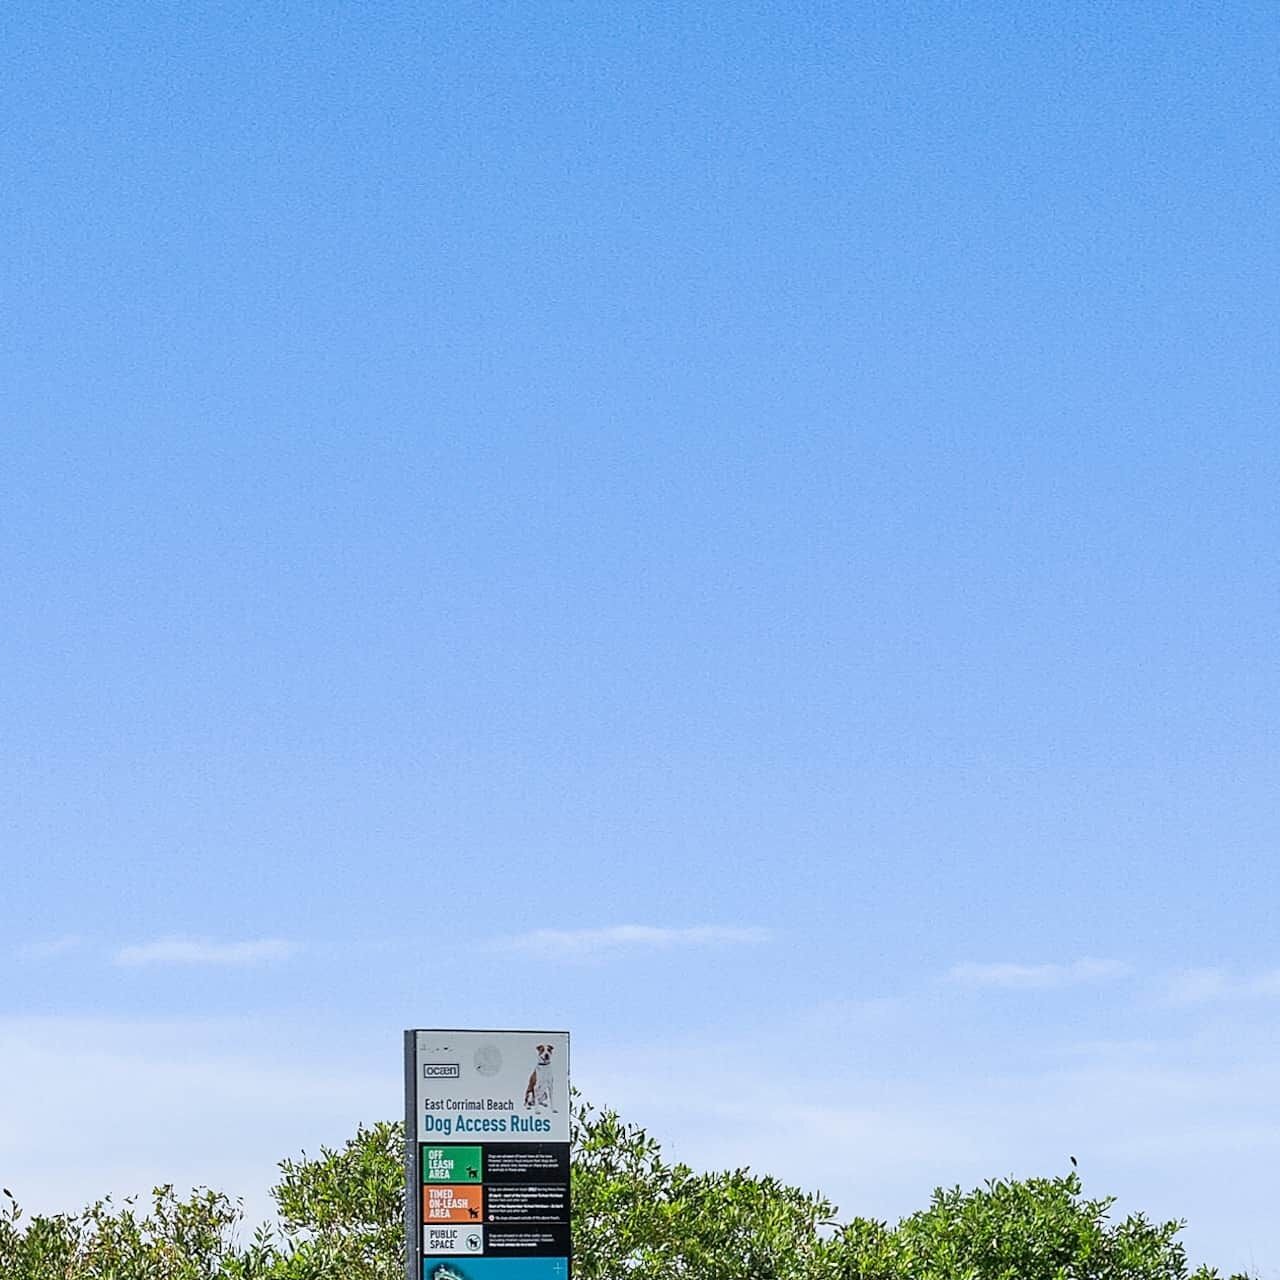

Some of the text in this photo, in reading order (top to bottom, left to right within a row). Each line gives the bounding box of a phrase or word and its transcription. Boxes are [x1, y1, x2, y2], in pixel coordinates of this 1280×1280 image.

[425, 1099, 514, 1110] East Corrimal Beach
[425, 1115, 551, 1135] Dog Access Rules
[428, 1150, 443, 1160] OFF
[428, 1160, 454, 1169] LEASH
[428, 1170, 451, 1179] AREA
[429, 1189, 454, 1198] TIMED
[429, 1199, 468, 1208] ON-LEASH
[429, 1209, 451, 1218] AREA
[430, 1230, 458, 1239] PUBLIC
[430, 1240, 455, 1249] SPACE
